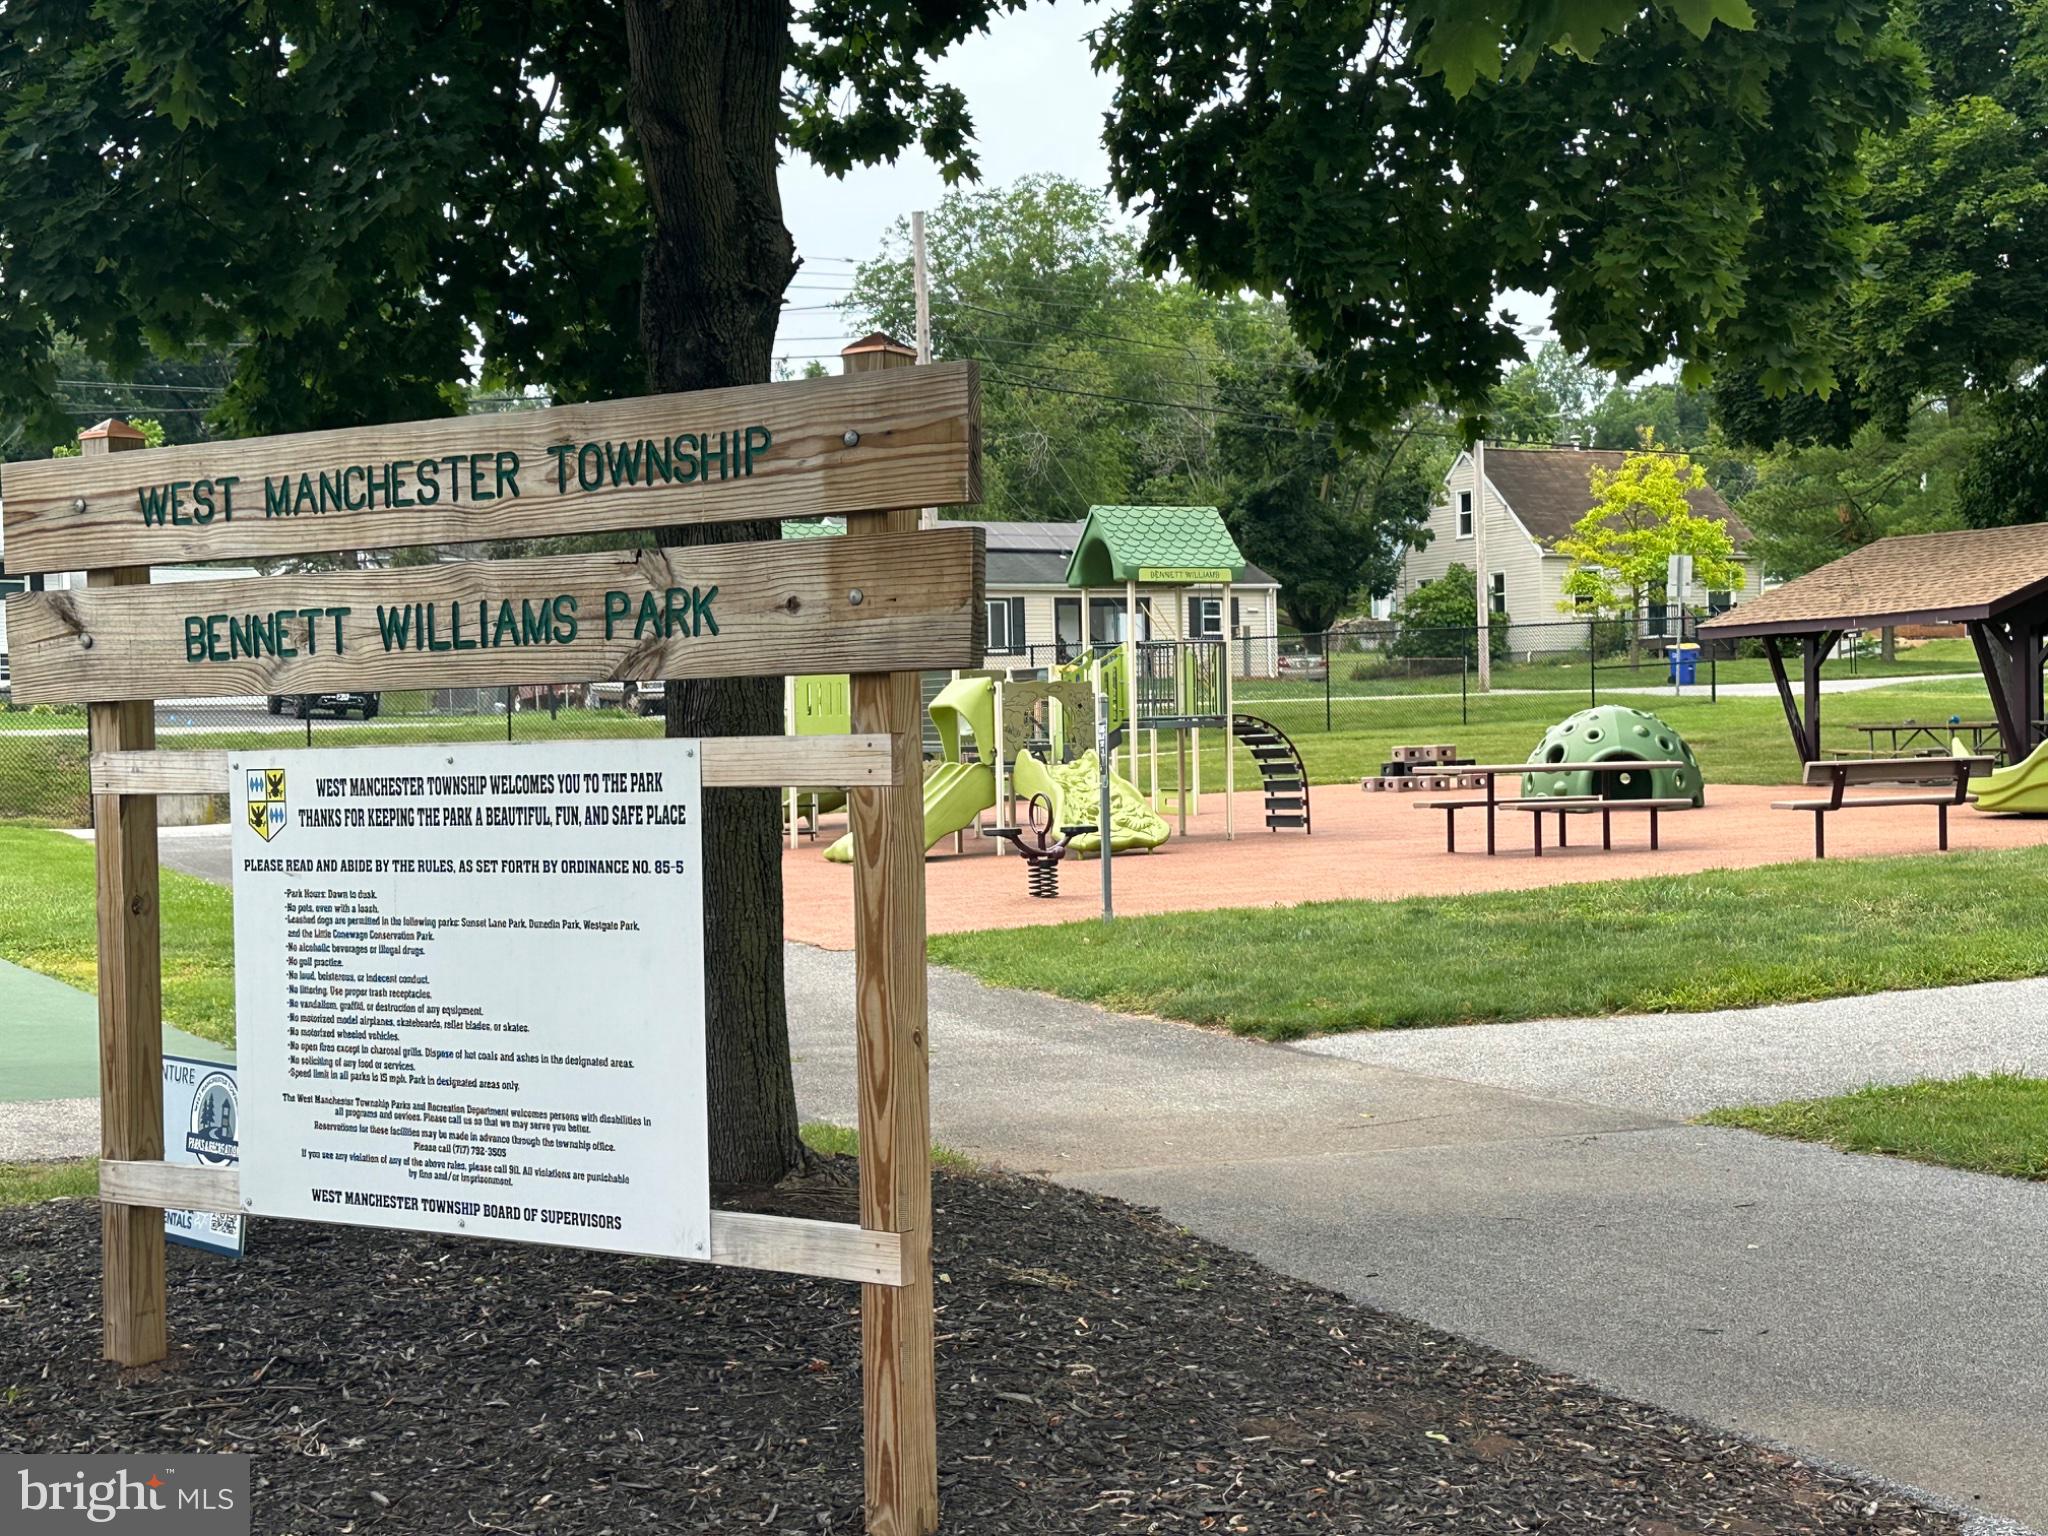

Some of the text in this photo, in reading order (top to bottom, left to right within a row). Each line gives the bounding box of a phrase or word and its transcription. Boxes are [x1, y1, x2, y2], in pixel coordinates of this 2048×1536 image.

[138, 425, 772, 527] WEST MANCHESTER TOWNSHIP
[185, 585, 720, 663] BENNETT WILLIAMS PARK
[316, 772, 662, 796] WEST MANCHESTER TOWNSHIP WELCOMES YOU TO THE PARK
[298, 804, 685, 826] THANKS FOR KEEPING THE PARK A BEAUTIFUL, FUN, AND SAFE PLACE
[244, 859, 683, 873] PLEASE READ AND ABIDE BY THE RULES, AS SET FORTH BY ORDINANCE NO. 85-5
[312, 1188, 621, 1229] WEST MANCHESTER TOWNSHIP BOARD OF SUPERVISORS
